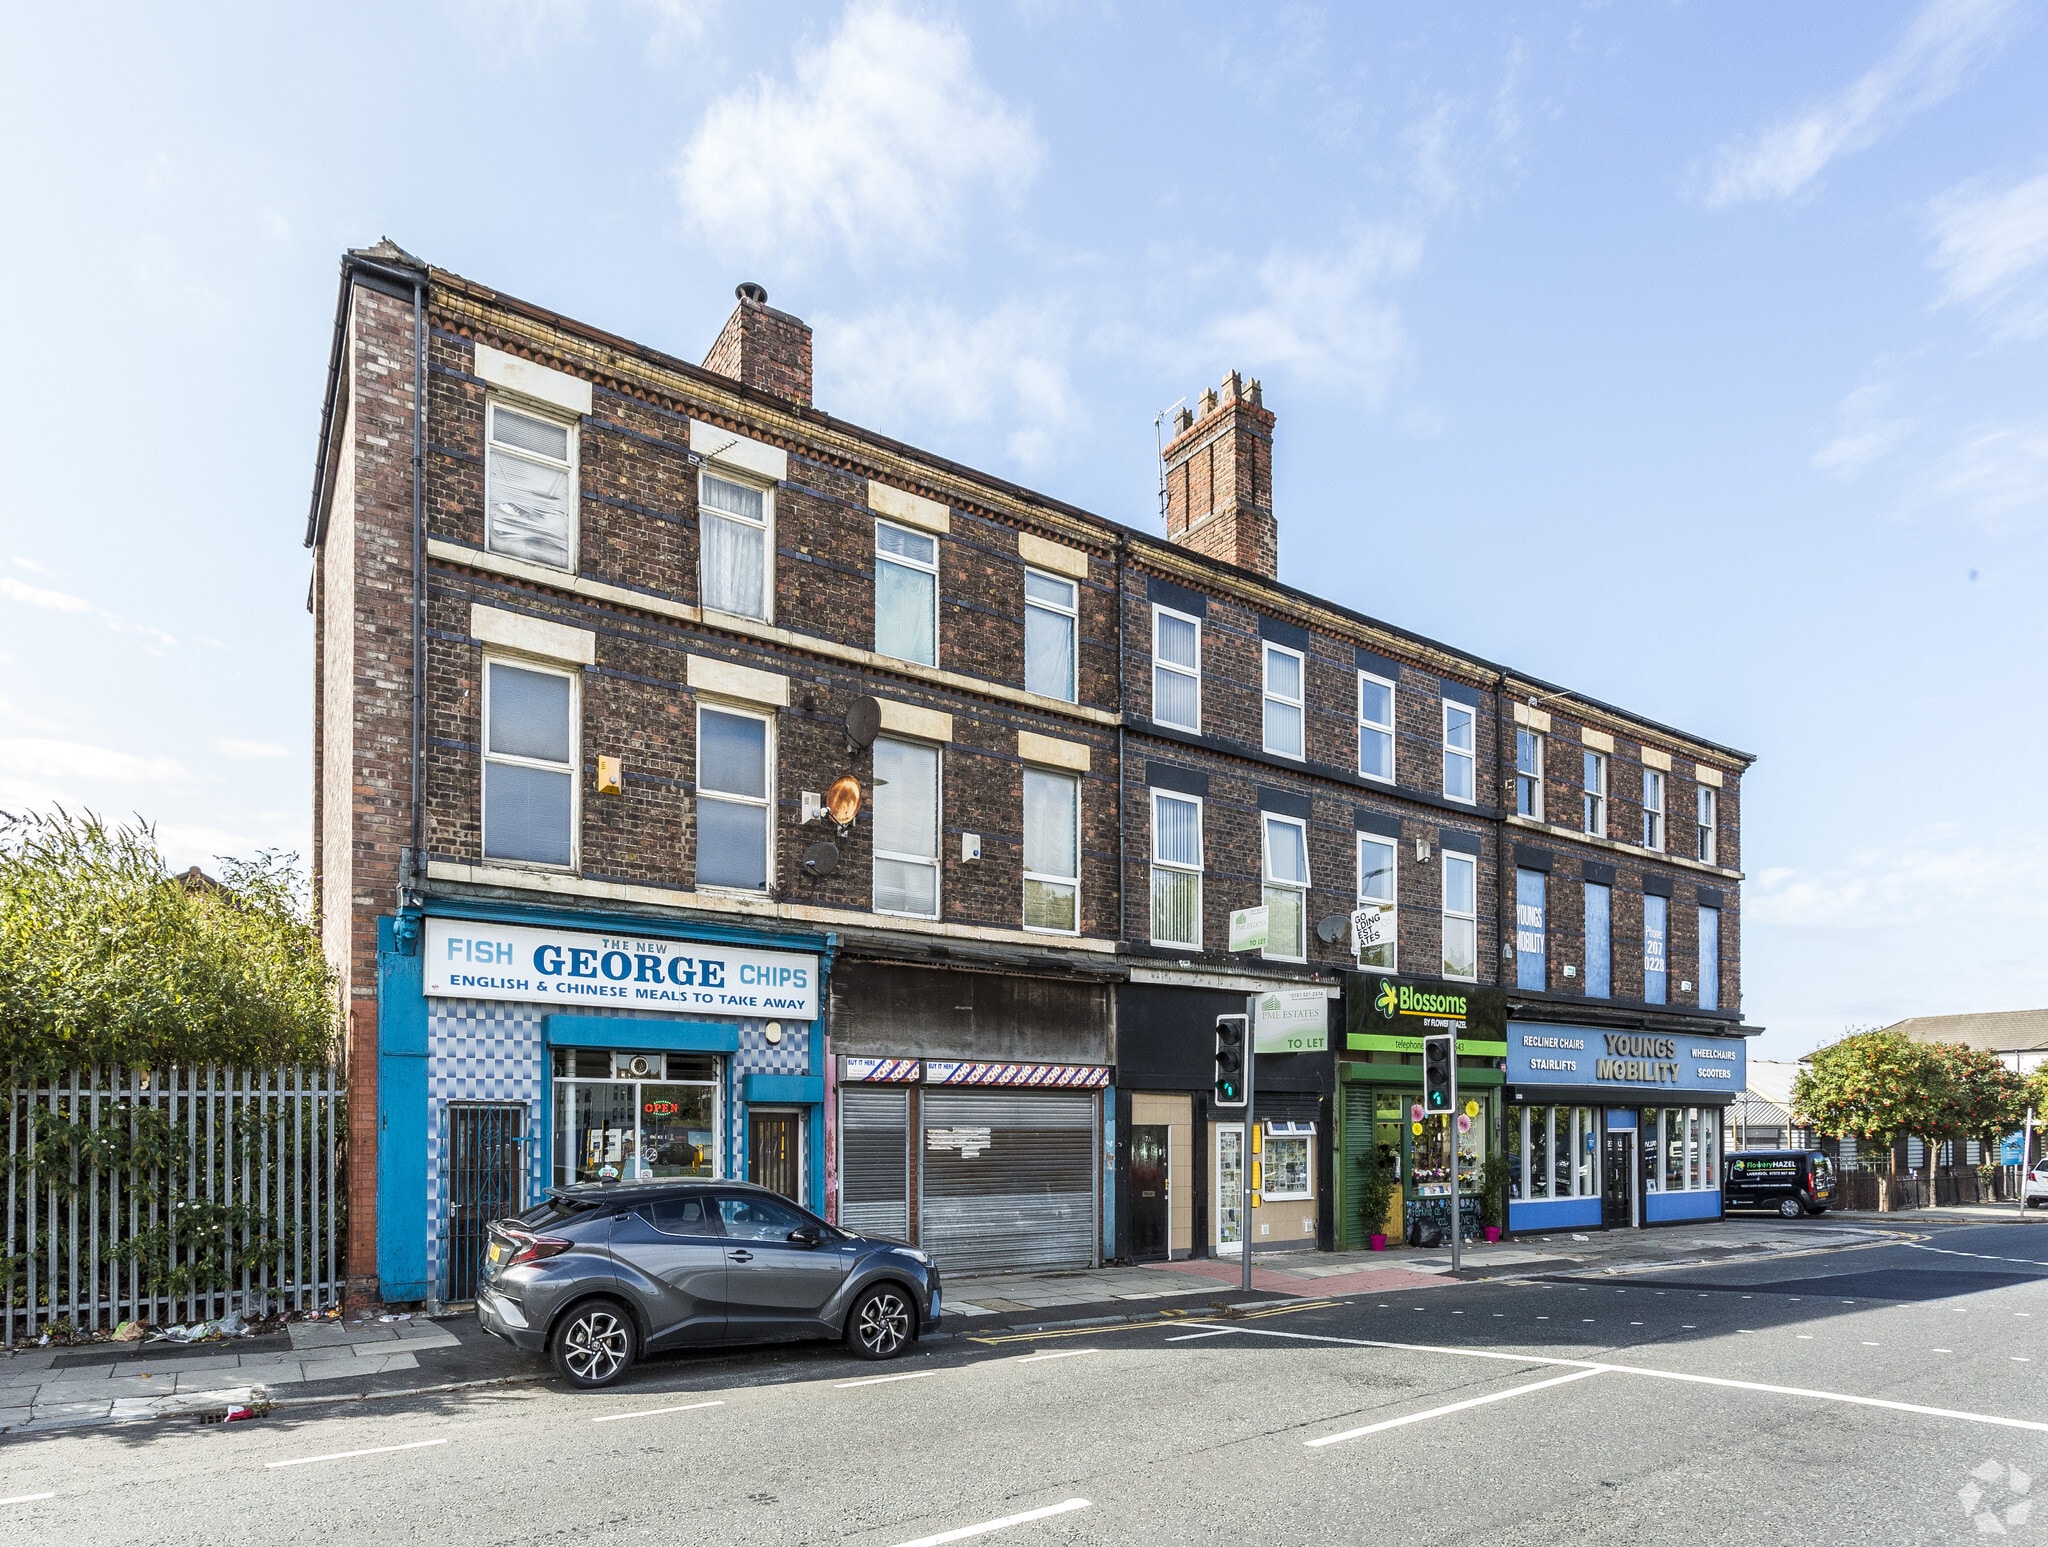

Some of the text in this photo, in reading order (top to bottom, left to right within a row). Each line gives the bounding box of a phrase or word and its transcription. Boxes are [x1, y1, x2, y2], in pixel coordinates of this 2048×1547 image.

[1355, 913, 1366, 924] GO
[1356, 914, 1380, 931] LDING
[1517, 904, 1542, 928] YOUNGS
[1247, 920, 1266, 929] ESTATES
[1358, 926, 1372, 939] EST
[1361, 931, 1380, 946] ATES
[602, 938, 668, 954] THE NEW
[1647, 940, 1662, 956] 207
[447, 938, 808, 989] FISH GEORGE CHIPS
[1644, 956, 1664, 972] 0228
[450, 974, 806, 1010] ENGLISH & CHINESE MEALS TO TAKE AWAY
[1400, 986, 1467, 1014] Blossoms
[1262, 1008, 1319, 1020] PME ESTATES
[1424, 1018, 1430, 1026] BY
[1288, 1038, 1324, 1048] TO LET
[1524, 1036, 1584, 1050] RECLINER CHAIRS
[1604, 1034, 1677, 1058] YOUNGS
[1691, 1048, 1736, 1060] WHEELCHAIRS
[873, 1059, 894, 1081] ECHO
[890, 1060, 910, 1082] ECHO
[1530, 1058, 1576, 1070] STAIRLIFTS
[1597, 1059, 1681, 1082] MOBILITY
[1698, 1067, 1731, 1079] SCOOTERS
[644, 1103, 678, 1112] OPEN
